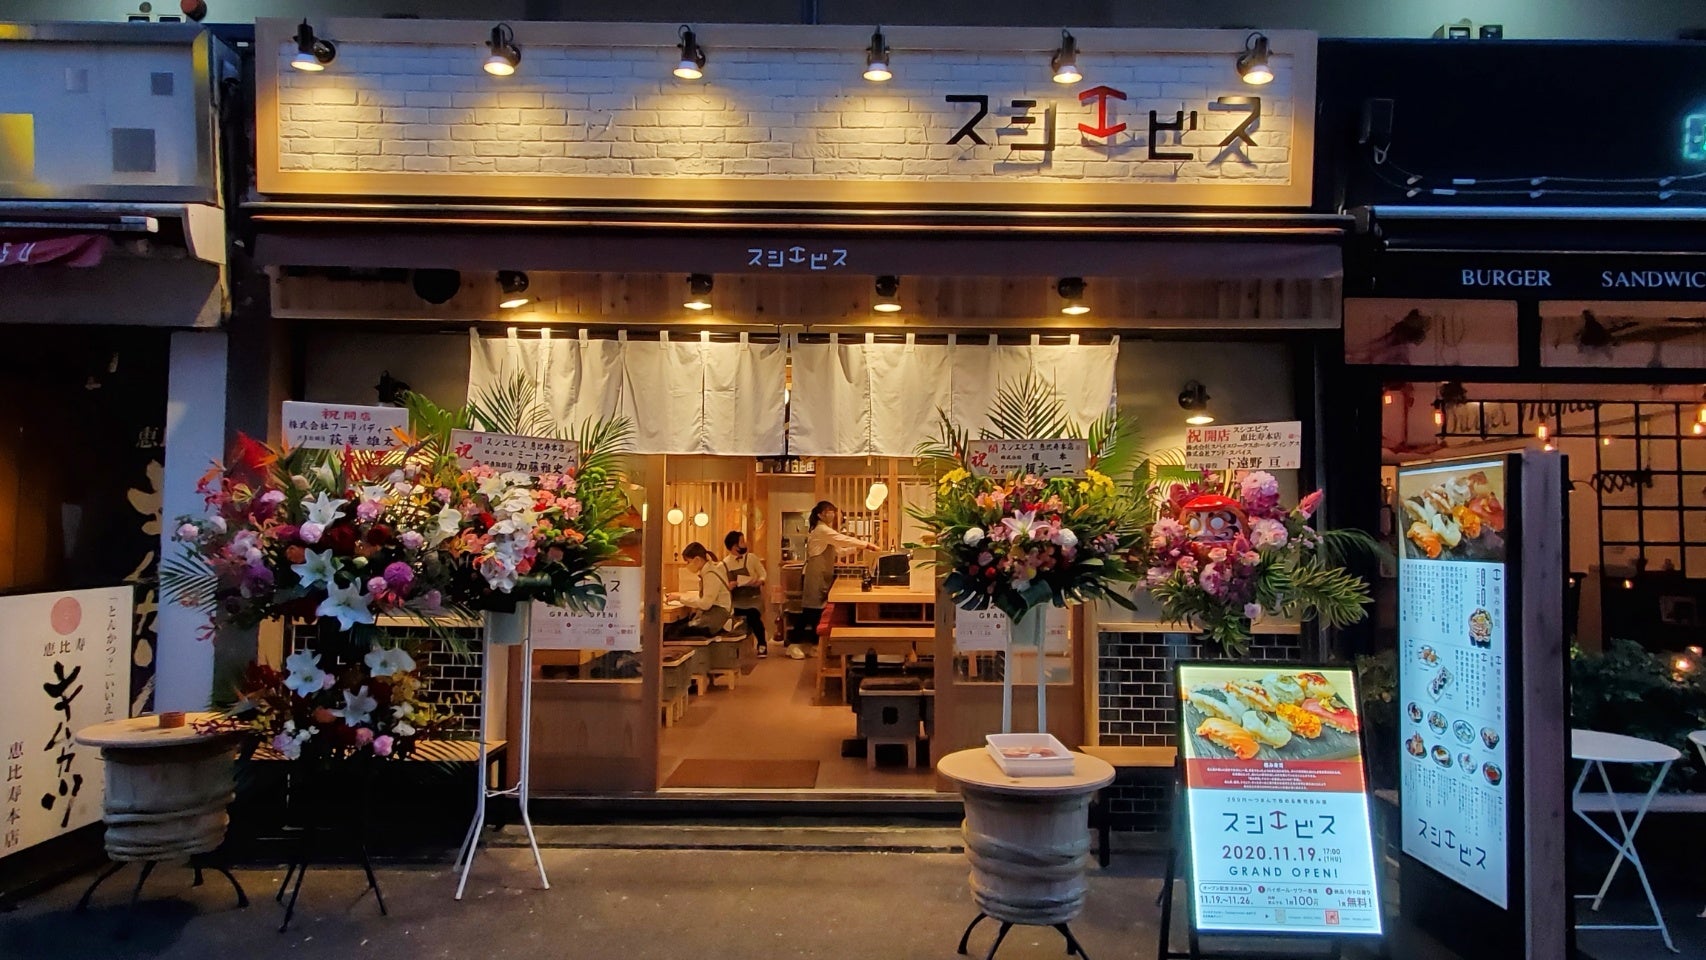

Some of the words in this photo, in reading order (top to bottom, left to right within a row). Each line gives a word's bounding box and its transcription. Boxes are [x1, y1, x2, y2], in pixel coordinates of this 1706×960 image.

[945, 85, 1261, 160] スシエビス
[747, 246, 848, 270] スシエビス
[1461, 269, 1552, 287] BURGER
[321, 408, 371, 421] 祝開店
[1187, 428, 1231, 443] 祝開店
[1233, 424, 1269, 434] スシエビス
[1240, 431, 1282, 441] 恵比寿本店
[454, 441, 473, 460] 祝
[972, 450, 989, 467] 祝
[43, 640, 85, 657] 恵比寿
[4, 740, 24, 849] 恵比寿本店
[1222, 811, 1336, 839] スシエビス
[1418, 818, 1486, 870] スシエビス
[1222, 845, 1323, 862] 2020.11.19.
[1323, 848, 1341, 856] 17:00
[1323, 855, 1342, 864] (THU)
[1229, 865, 1282, 877] GRAND
[1291, 867, 1339, 879] OPEN!
